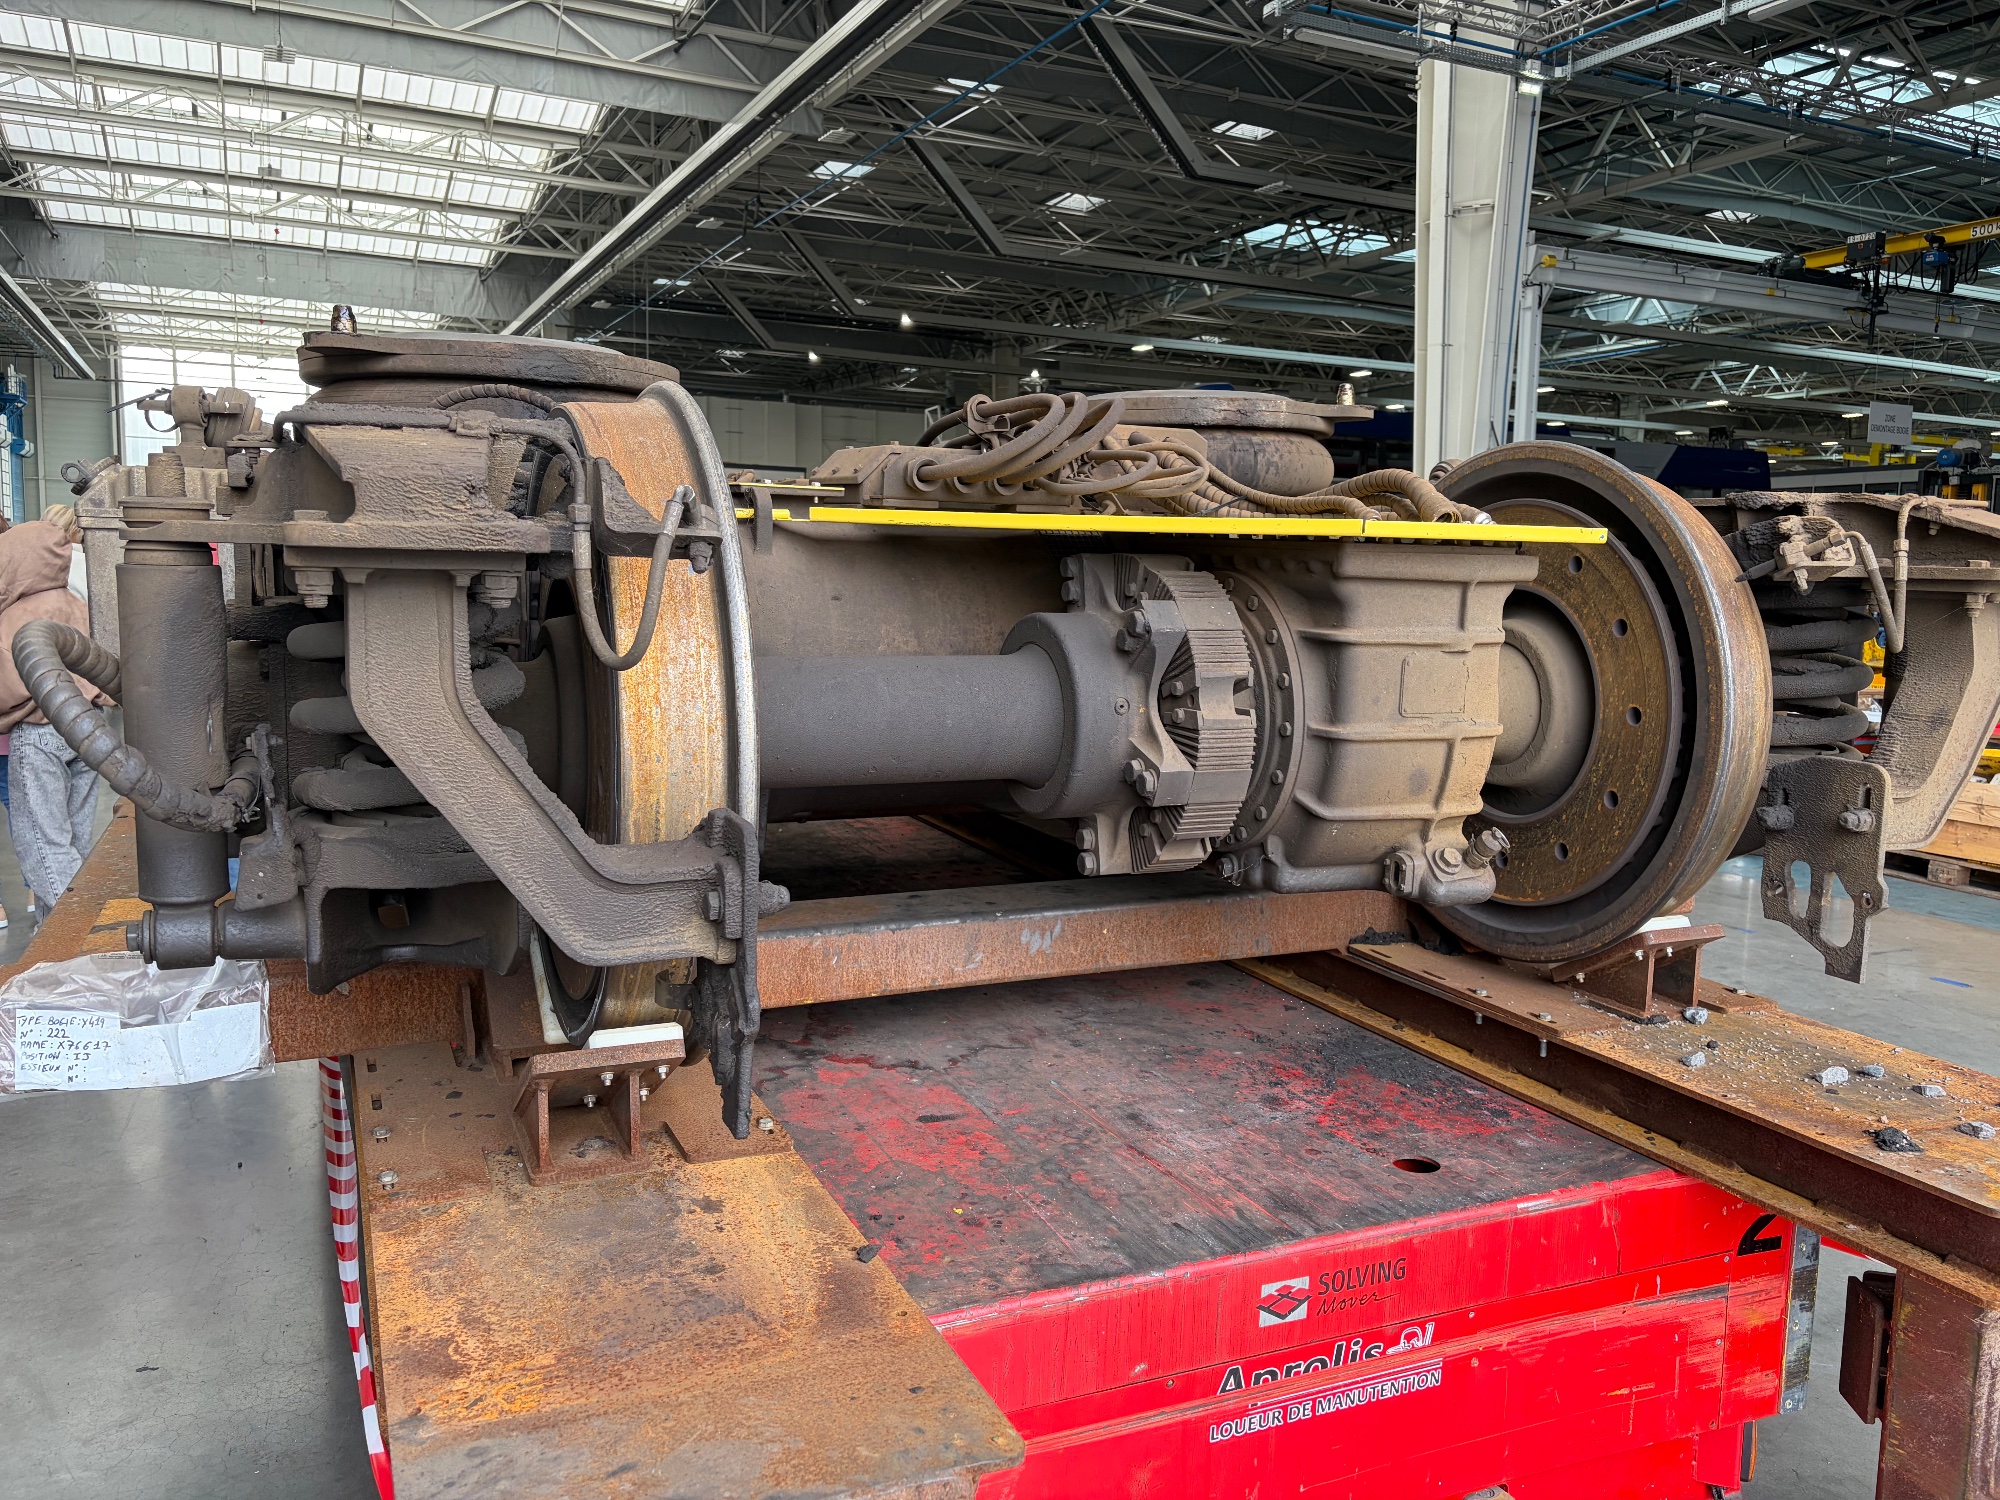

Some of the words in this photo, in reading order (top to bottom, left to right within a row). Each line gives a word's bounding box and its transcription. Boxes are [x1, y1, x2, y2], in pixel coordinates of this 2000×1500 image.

[1884, 414, 1896, 423] ZONE
[1896, 426, 1909, 435] BOGIE
[17, 1015, 43, 1027] TYPE
[47, 1027, 70, 1039] 222
[57, 1040, 111, 1051] X76617
[20, 1062, 61, 1073] ESSIEUX
[1317, 1257, 1406, 1296] SOLVING
[1316, 1291, 1400, 1317] Mover
[1209, 1408, 1284, 1442] LOUEUR
[1286, 1401, 1312, 1424] DE
[1315, 1368, 1442, 1416] MANUTENTION
